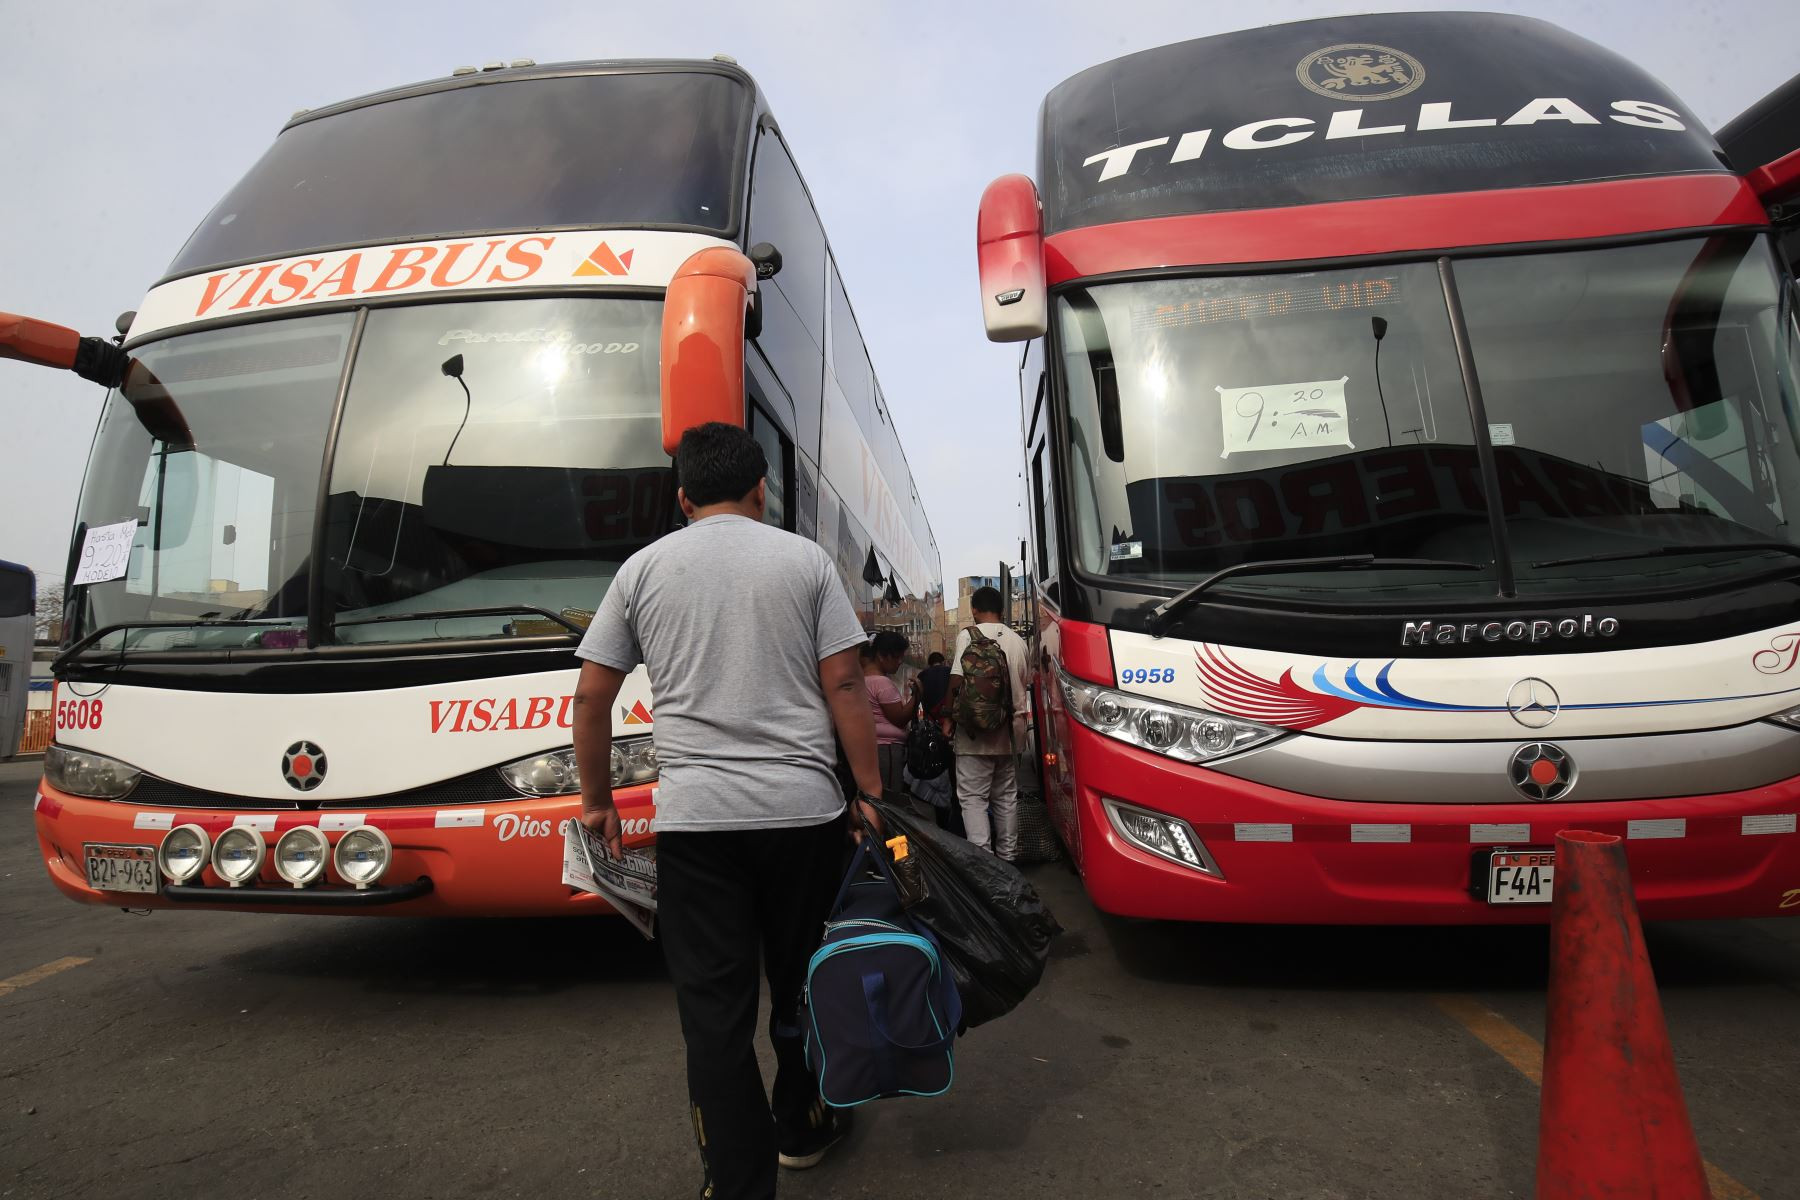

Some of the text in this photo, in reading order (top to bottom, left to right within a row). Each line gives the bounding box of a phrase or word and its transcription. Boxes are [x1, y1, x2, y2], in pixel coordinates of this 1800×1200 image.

[1083, 98, 1686, 183] TICLLAS
[196, 237, 555, 316] VISABUS
[1402, 614, 1620, 646] Marcopolo
[1121, 667, 1175, 685] 9958
[57, 698, 103, 730] 5608
[429, 696, 574, 733] VISABU
[493, 813, 551, 842] Dios
[90, 857, 153, 886] B2A-963
[1495, 866, 1551, 896] F4A-
